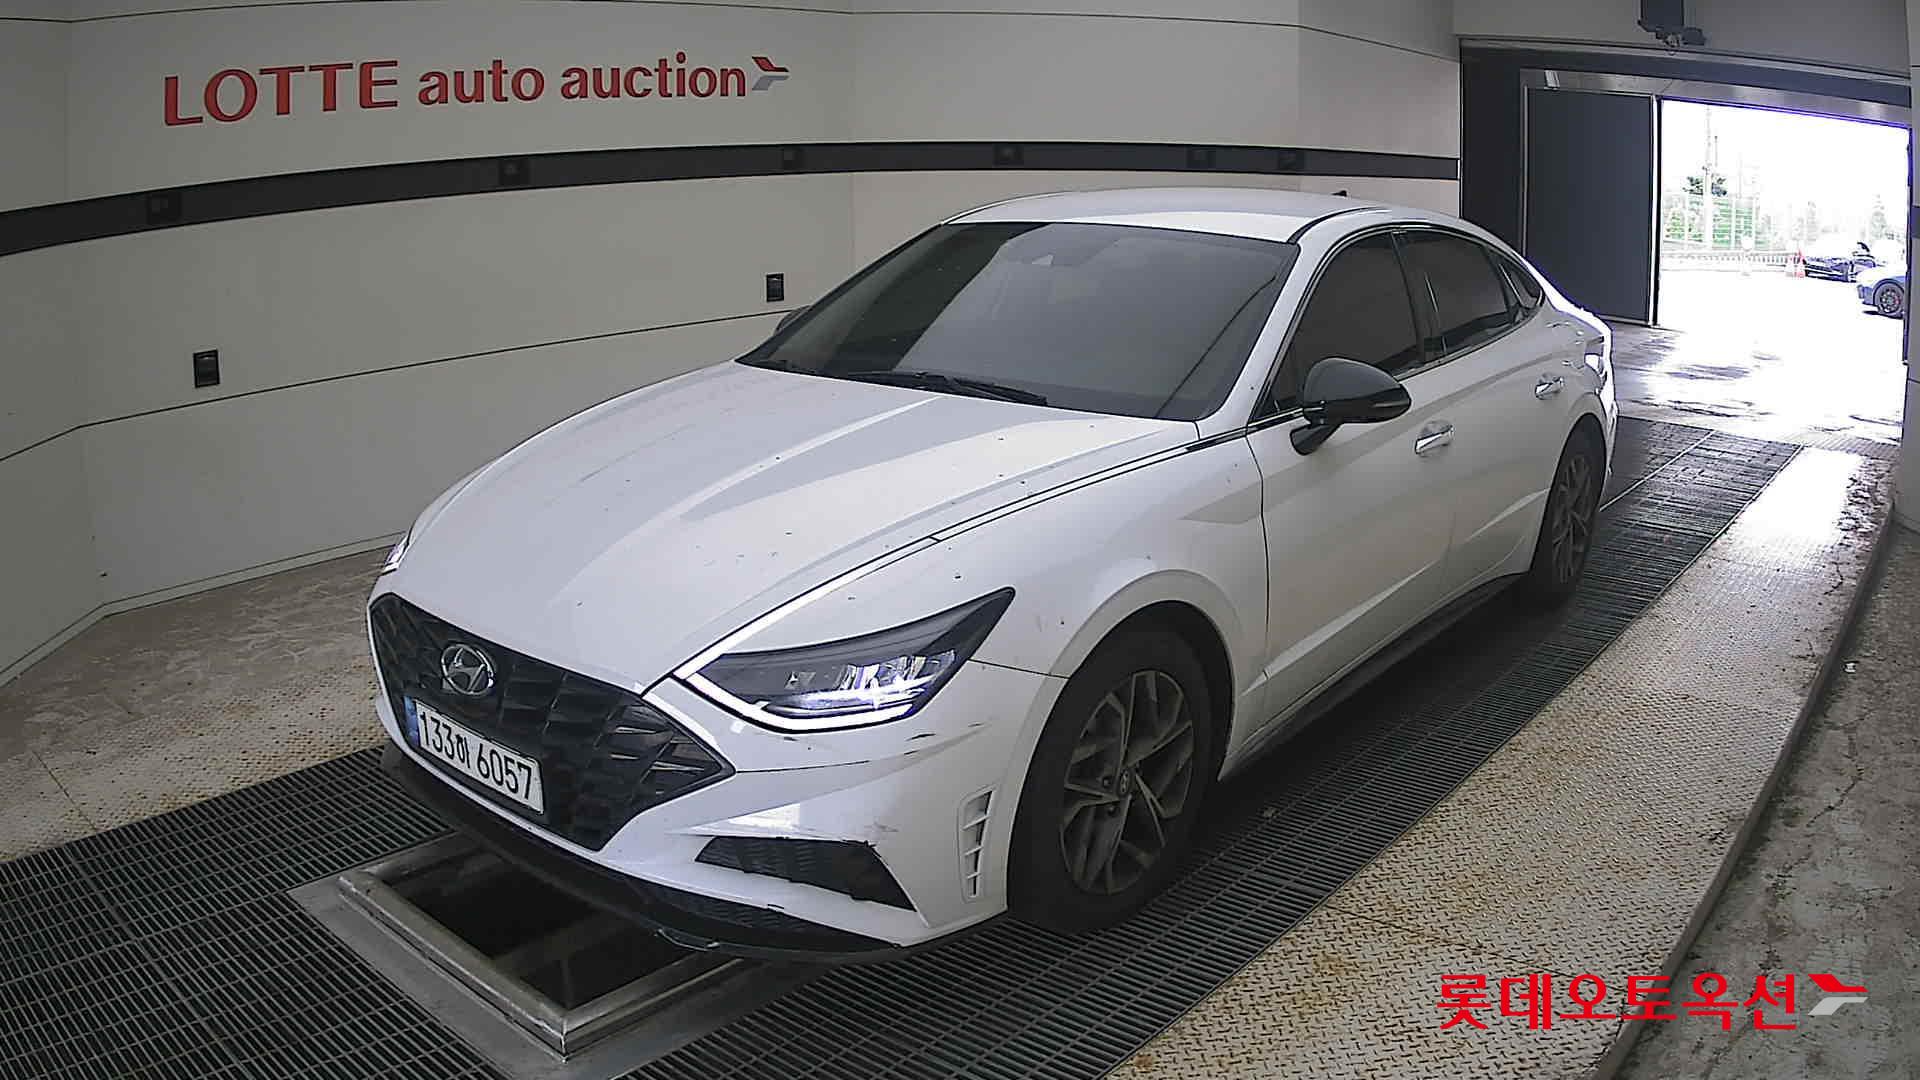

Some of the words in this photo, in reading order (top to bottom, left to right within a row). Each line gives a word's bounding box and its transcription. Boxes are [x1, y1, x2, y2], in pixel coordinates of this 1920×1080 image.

[164, 60, 399, 126] LOTTE
[417, 59, 545, 105] auto
[560, 51, 747, 99] auction
[477, 743, 532, 799] 6057
